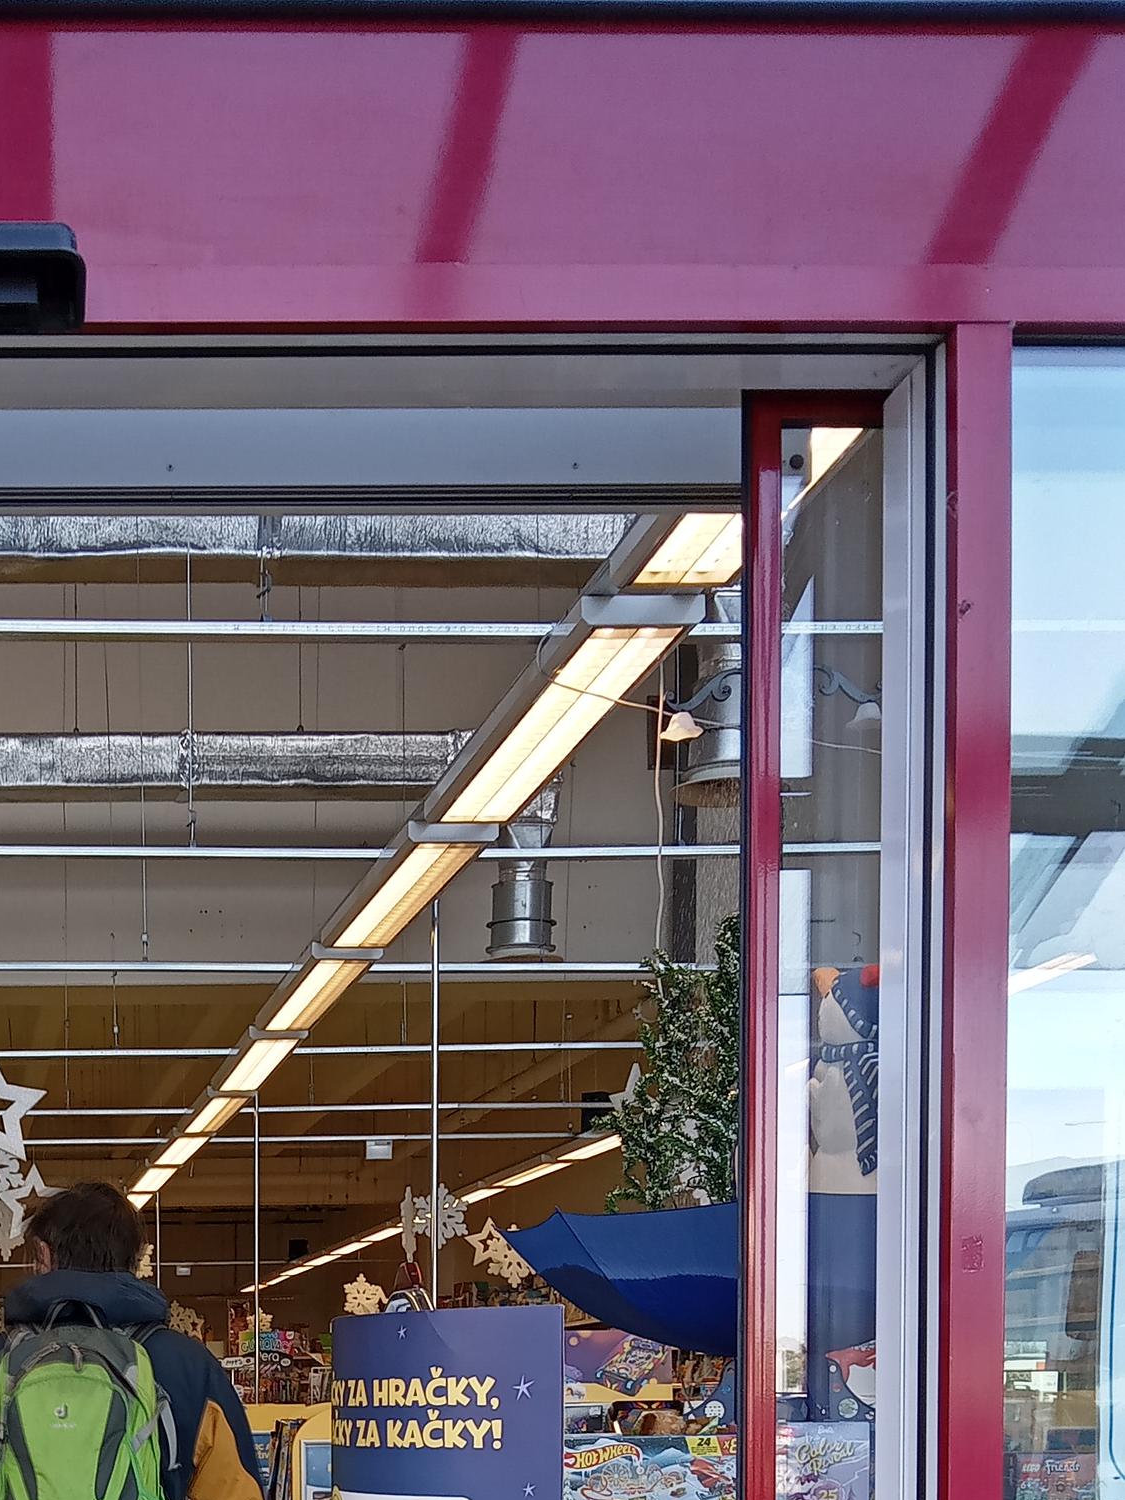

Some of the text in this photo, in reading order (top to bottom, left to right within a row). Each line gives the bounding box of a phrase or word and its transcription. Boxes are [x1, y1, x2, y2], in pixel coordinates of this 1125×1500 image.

[347, 1379, 368, 1407] ZA
[373, 1366, 500, 1410] HRAČKY,
[356, 1419, 381, 1448] ZA
[386, 1409, 503, 1450] KAČKY!
[697, 1437, 711, 1447] 24
[575, 1450, 600, 1468] HOT
[1021, 1459, 1081, 1475] LEGO Friends
[818, 1489, 838, 1500] 25
